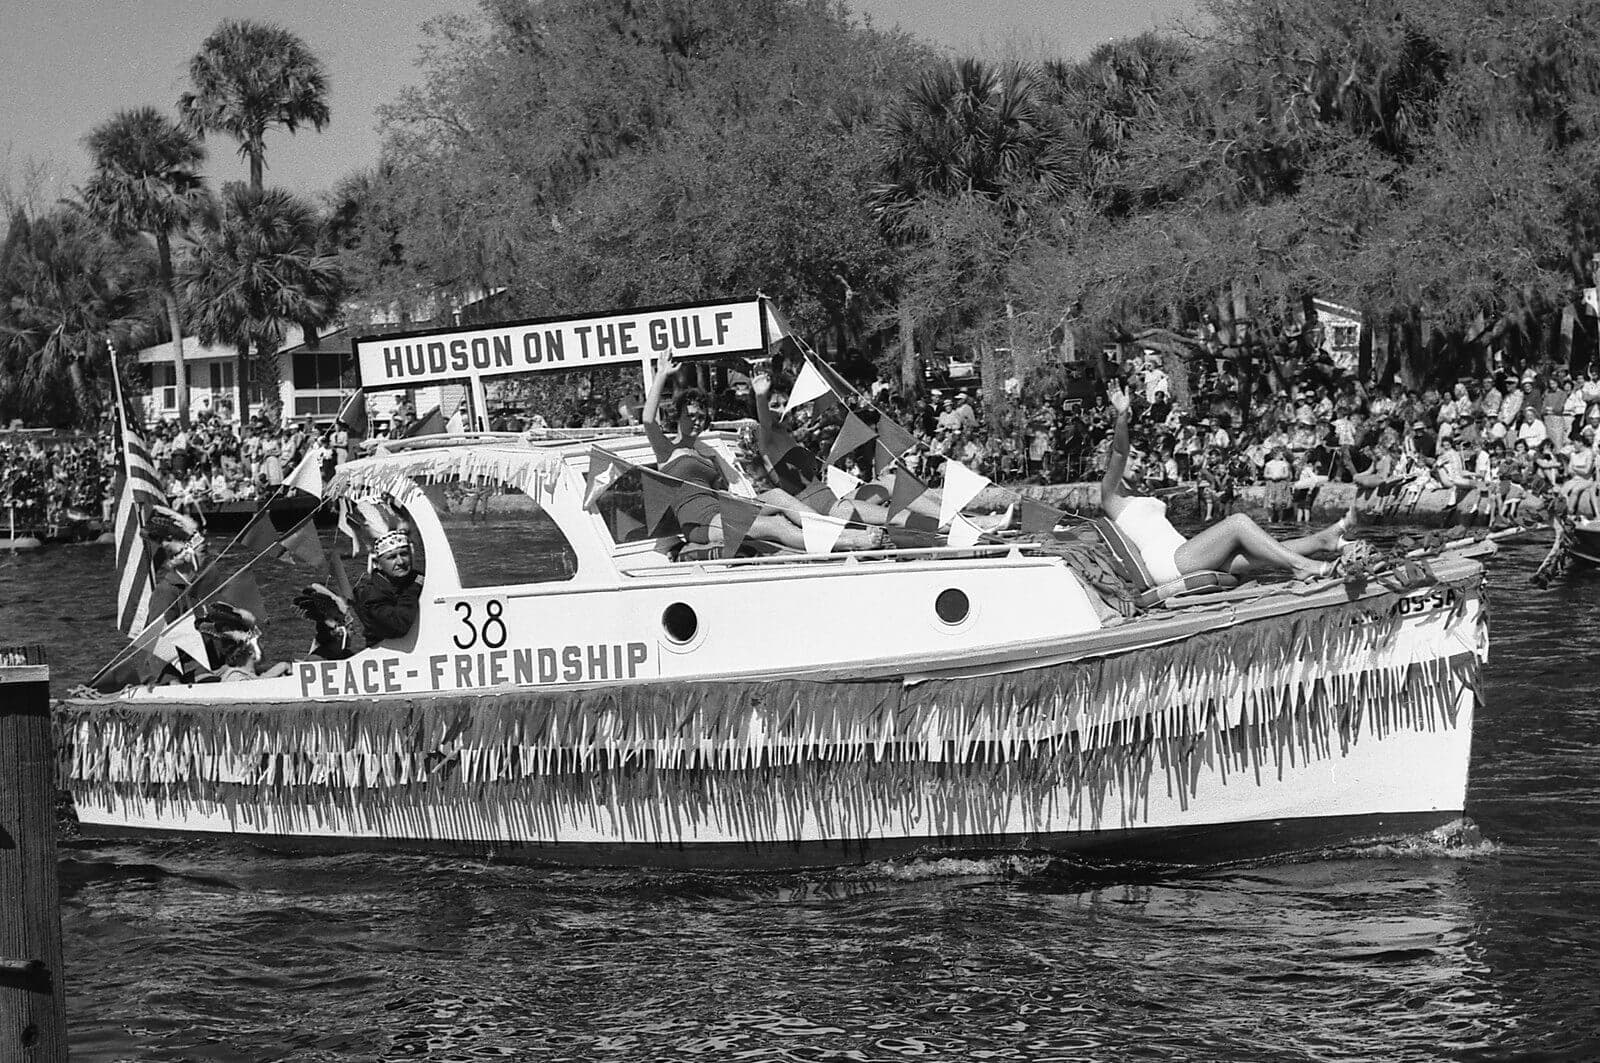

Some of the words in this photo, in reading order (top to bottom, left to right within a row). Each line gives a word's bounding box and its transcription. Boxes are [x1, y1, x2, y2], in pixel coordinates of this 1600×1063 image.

[384, 334, 514, 378] HUDSON
[523, 329, 565, 364] ON
[573, 321, 639, 359] THE
[648, 311, 733, 352] GULF
[453, 599, 508, 650] 38
[429, 642, 648, 690] FRIENDSHIP
